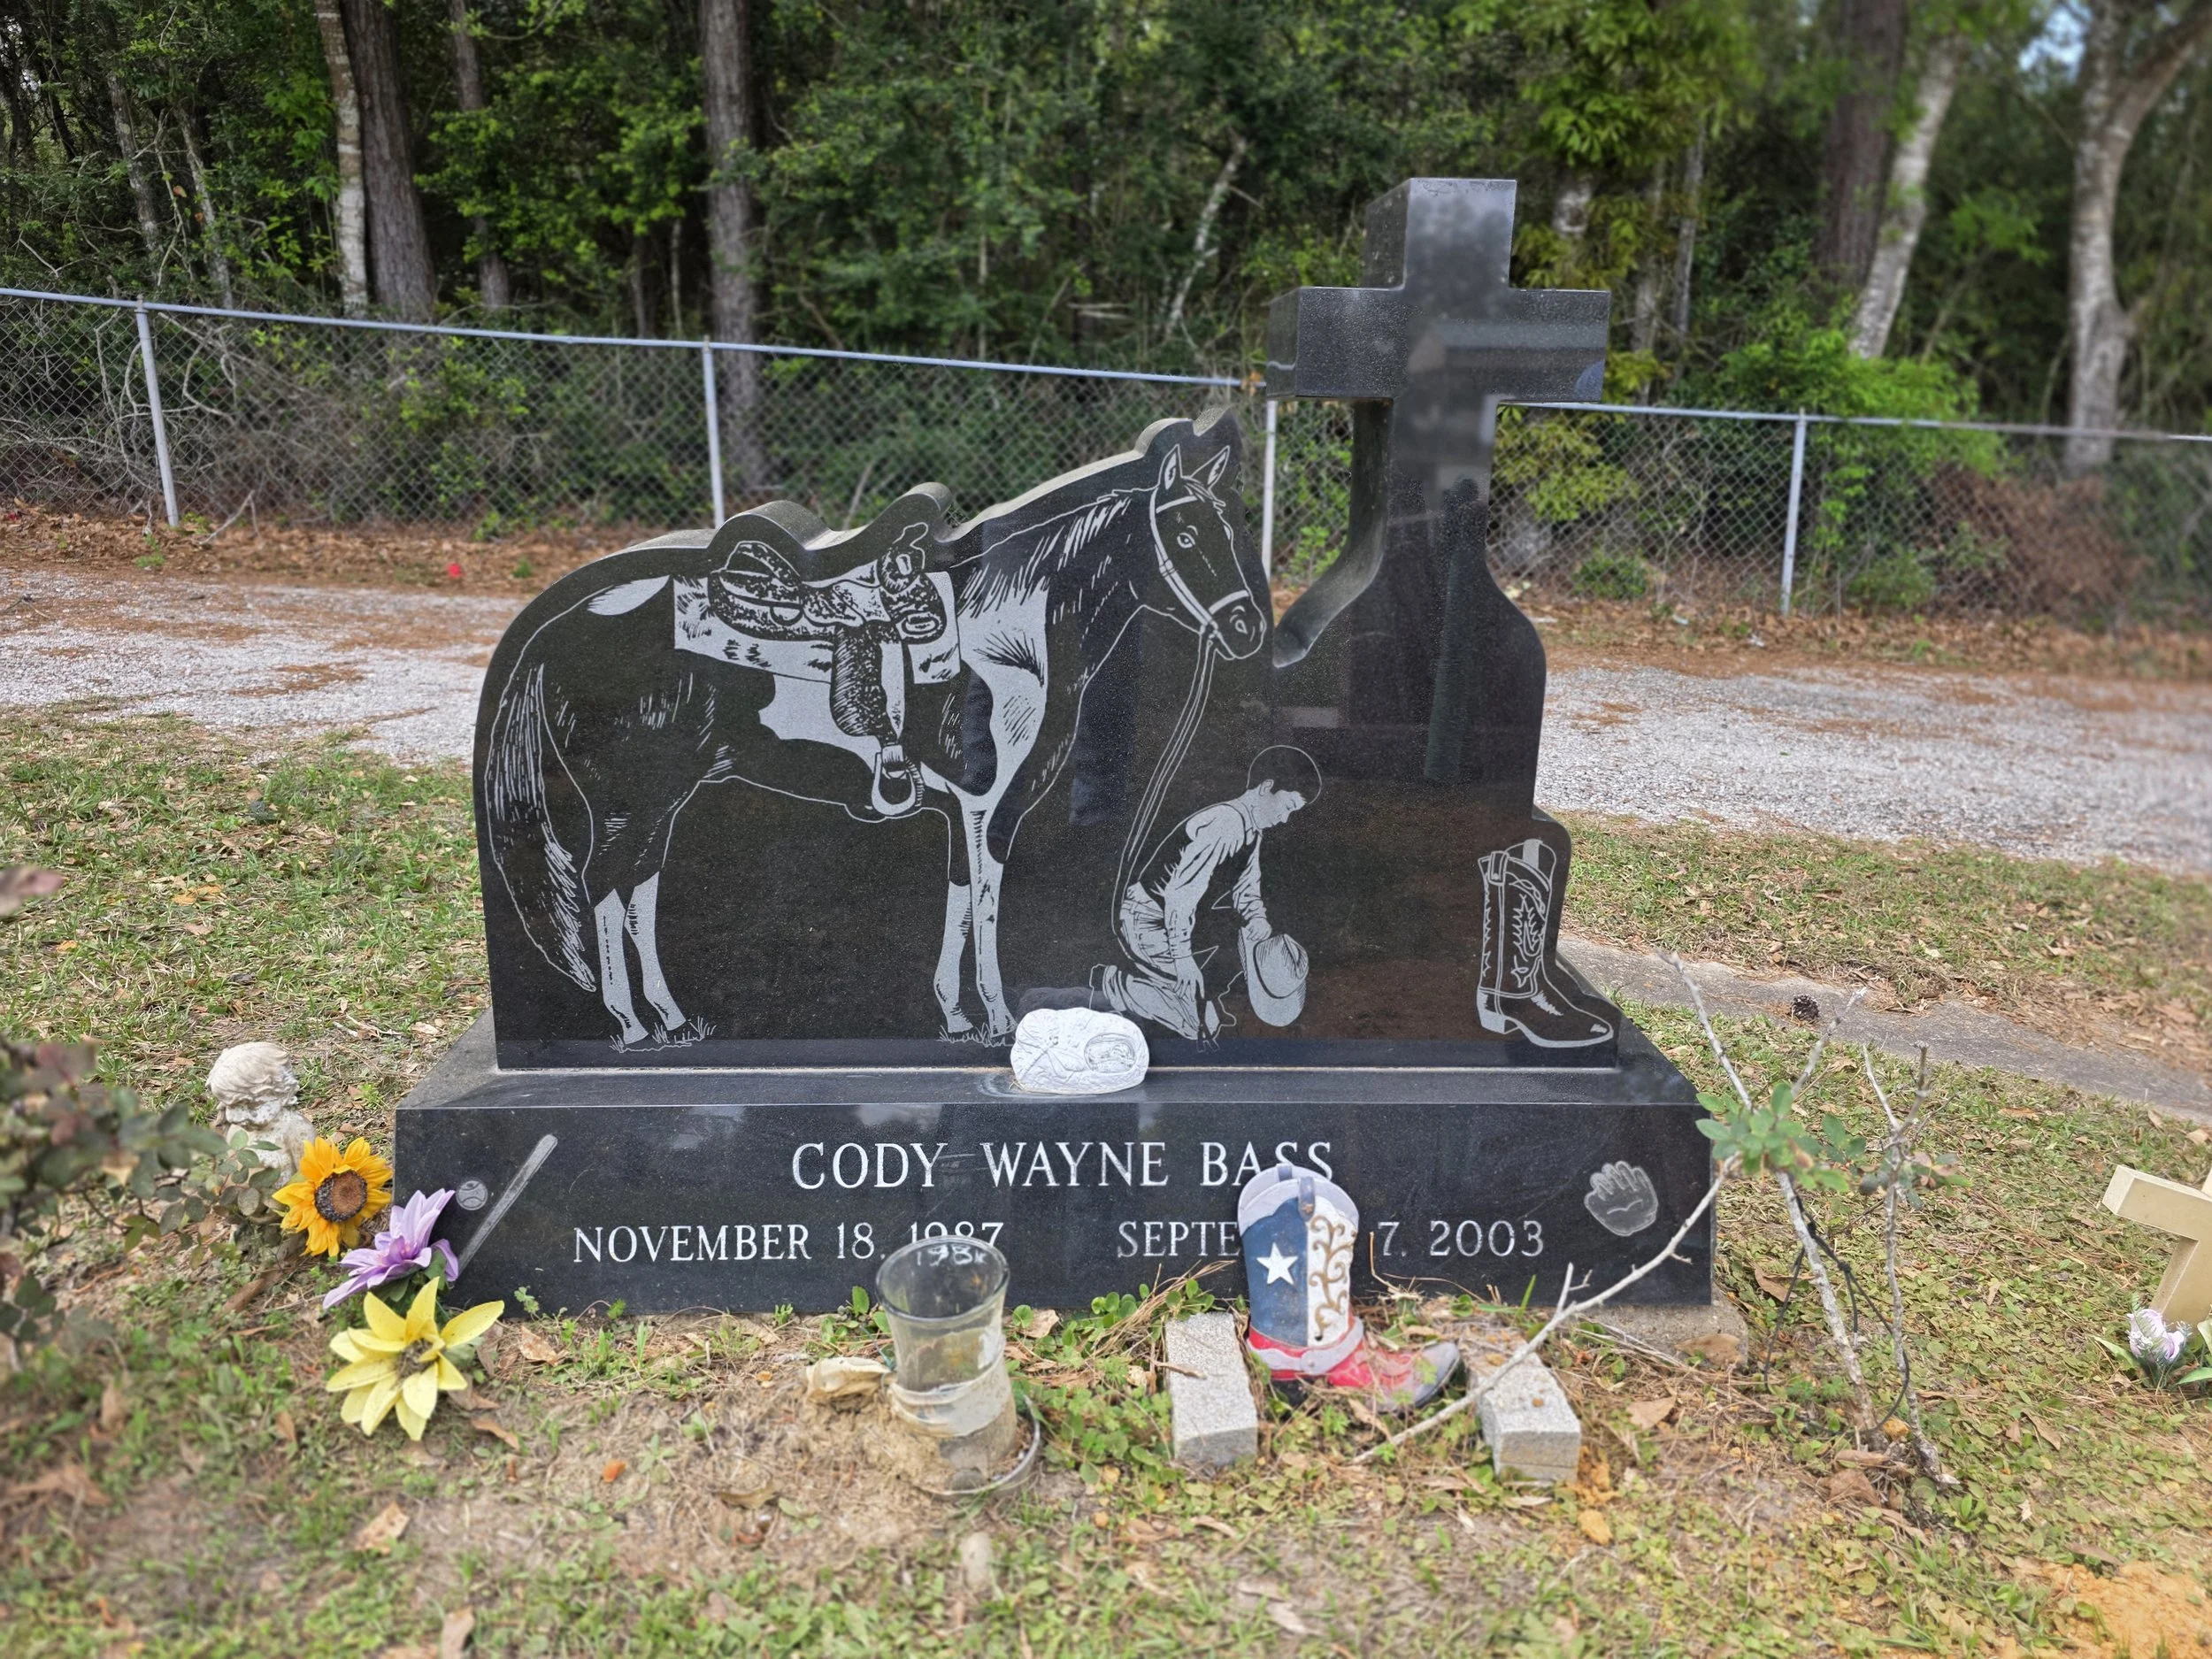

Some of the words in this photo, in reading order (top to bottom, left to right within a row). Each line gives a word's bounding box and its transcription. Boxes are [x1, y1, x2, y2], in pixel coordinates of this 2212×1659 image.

[793, 1142, 948, 1189] CODY
[979, 1141, 1169, 1187] WAYNE
[1200, 1141, 1333, 1187] BASS
[573, 1223, 812, 1263] NOVEMBER
[1118, 1221, 1240, 1257] SEPTE
[1430, 1219, 1544, 1257] 2003
